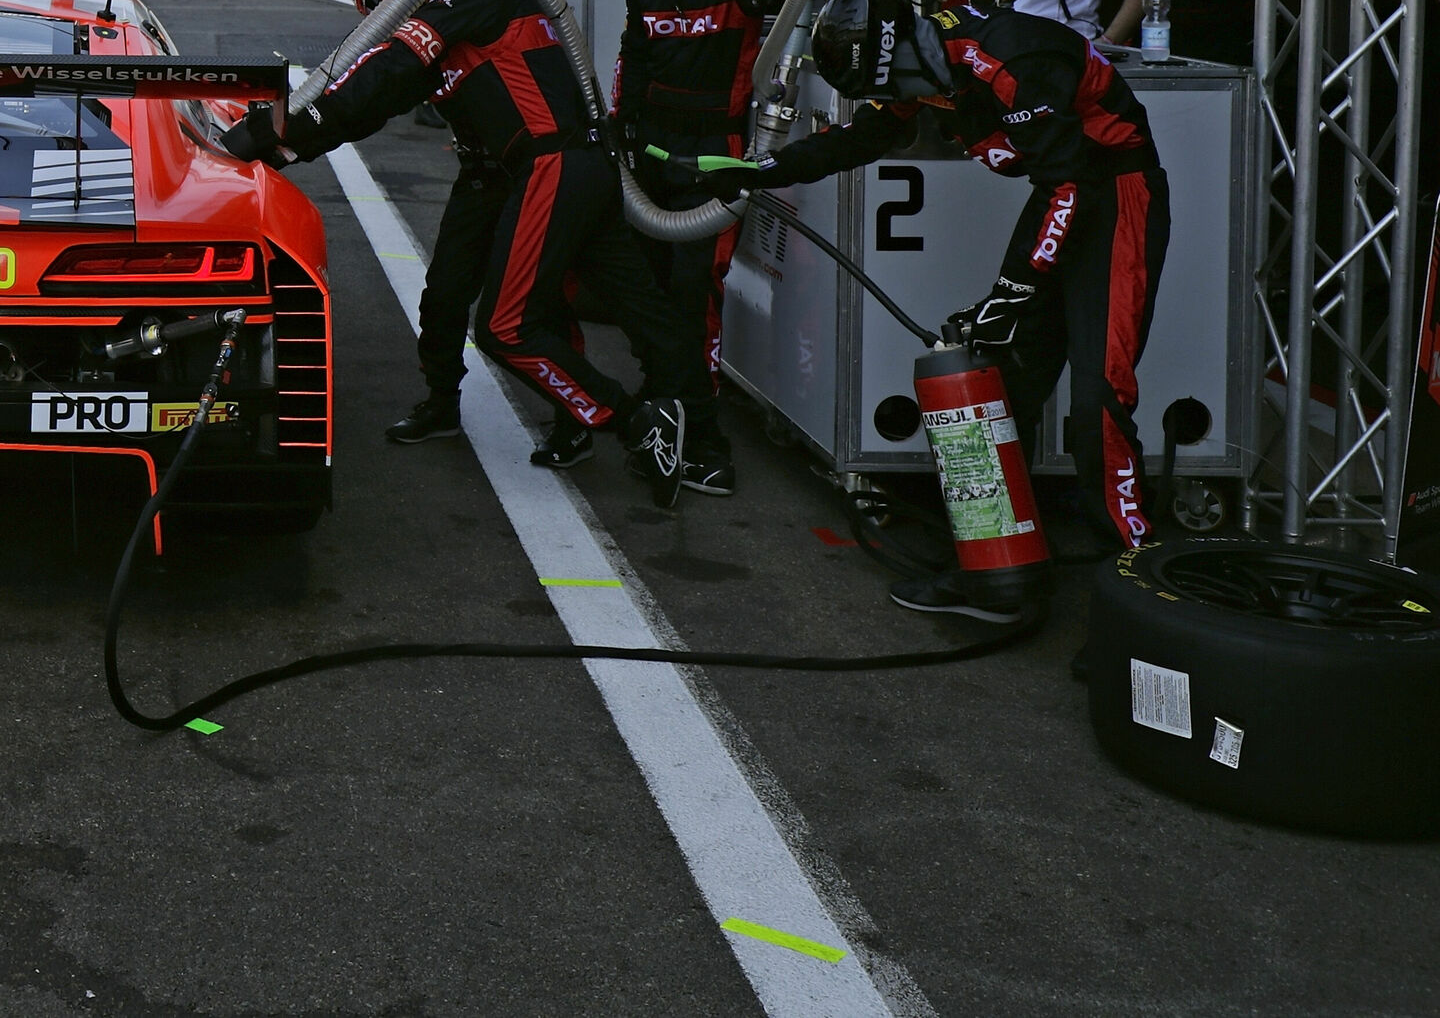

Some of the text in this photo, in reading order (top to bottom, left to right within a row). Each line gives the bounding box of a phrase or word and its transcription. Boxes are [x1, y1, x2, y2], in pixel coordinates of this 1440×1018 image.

[643, 15, 718, 35] TOTAL
[11, 64, 238, 83] Wisselstukken
[851, 43, 860, 70] uvex
[874, 20, 895, 86] uvex
[875, 165, 924, 252] 2
[1032, 192, 1074, 262] TOTAL
[50, 394, 130, 432] PRO
[538, 362, 598, 425] TOTAL
